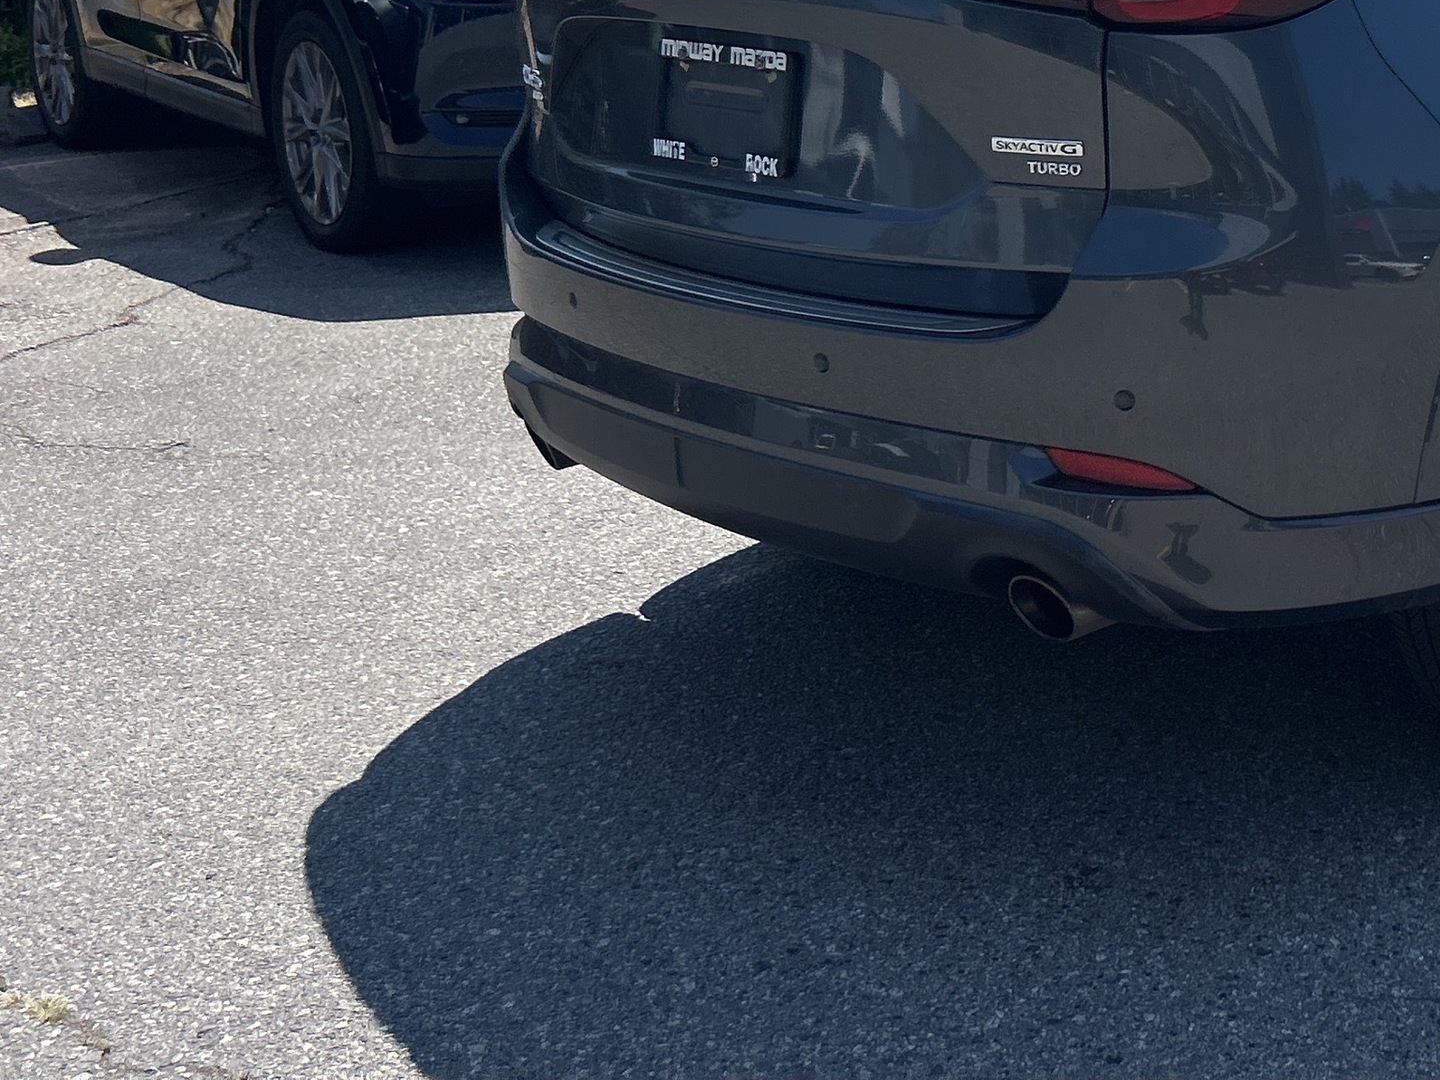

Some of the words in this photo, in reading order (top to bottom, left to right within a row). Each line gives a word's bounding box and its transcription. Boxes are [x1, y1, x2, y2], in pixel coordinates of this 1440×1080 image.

[653, 138, 686, 160] WHITE
[745, 153, 779, 177] ROCK
[1027, 161, 1082, 176] TURBO
